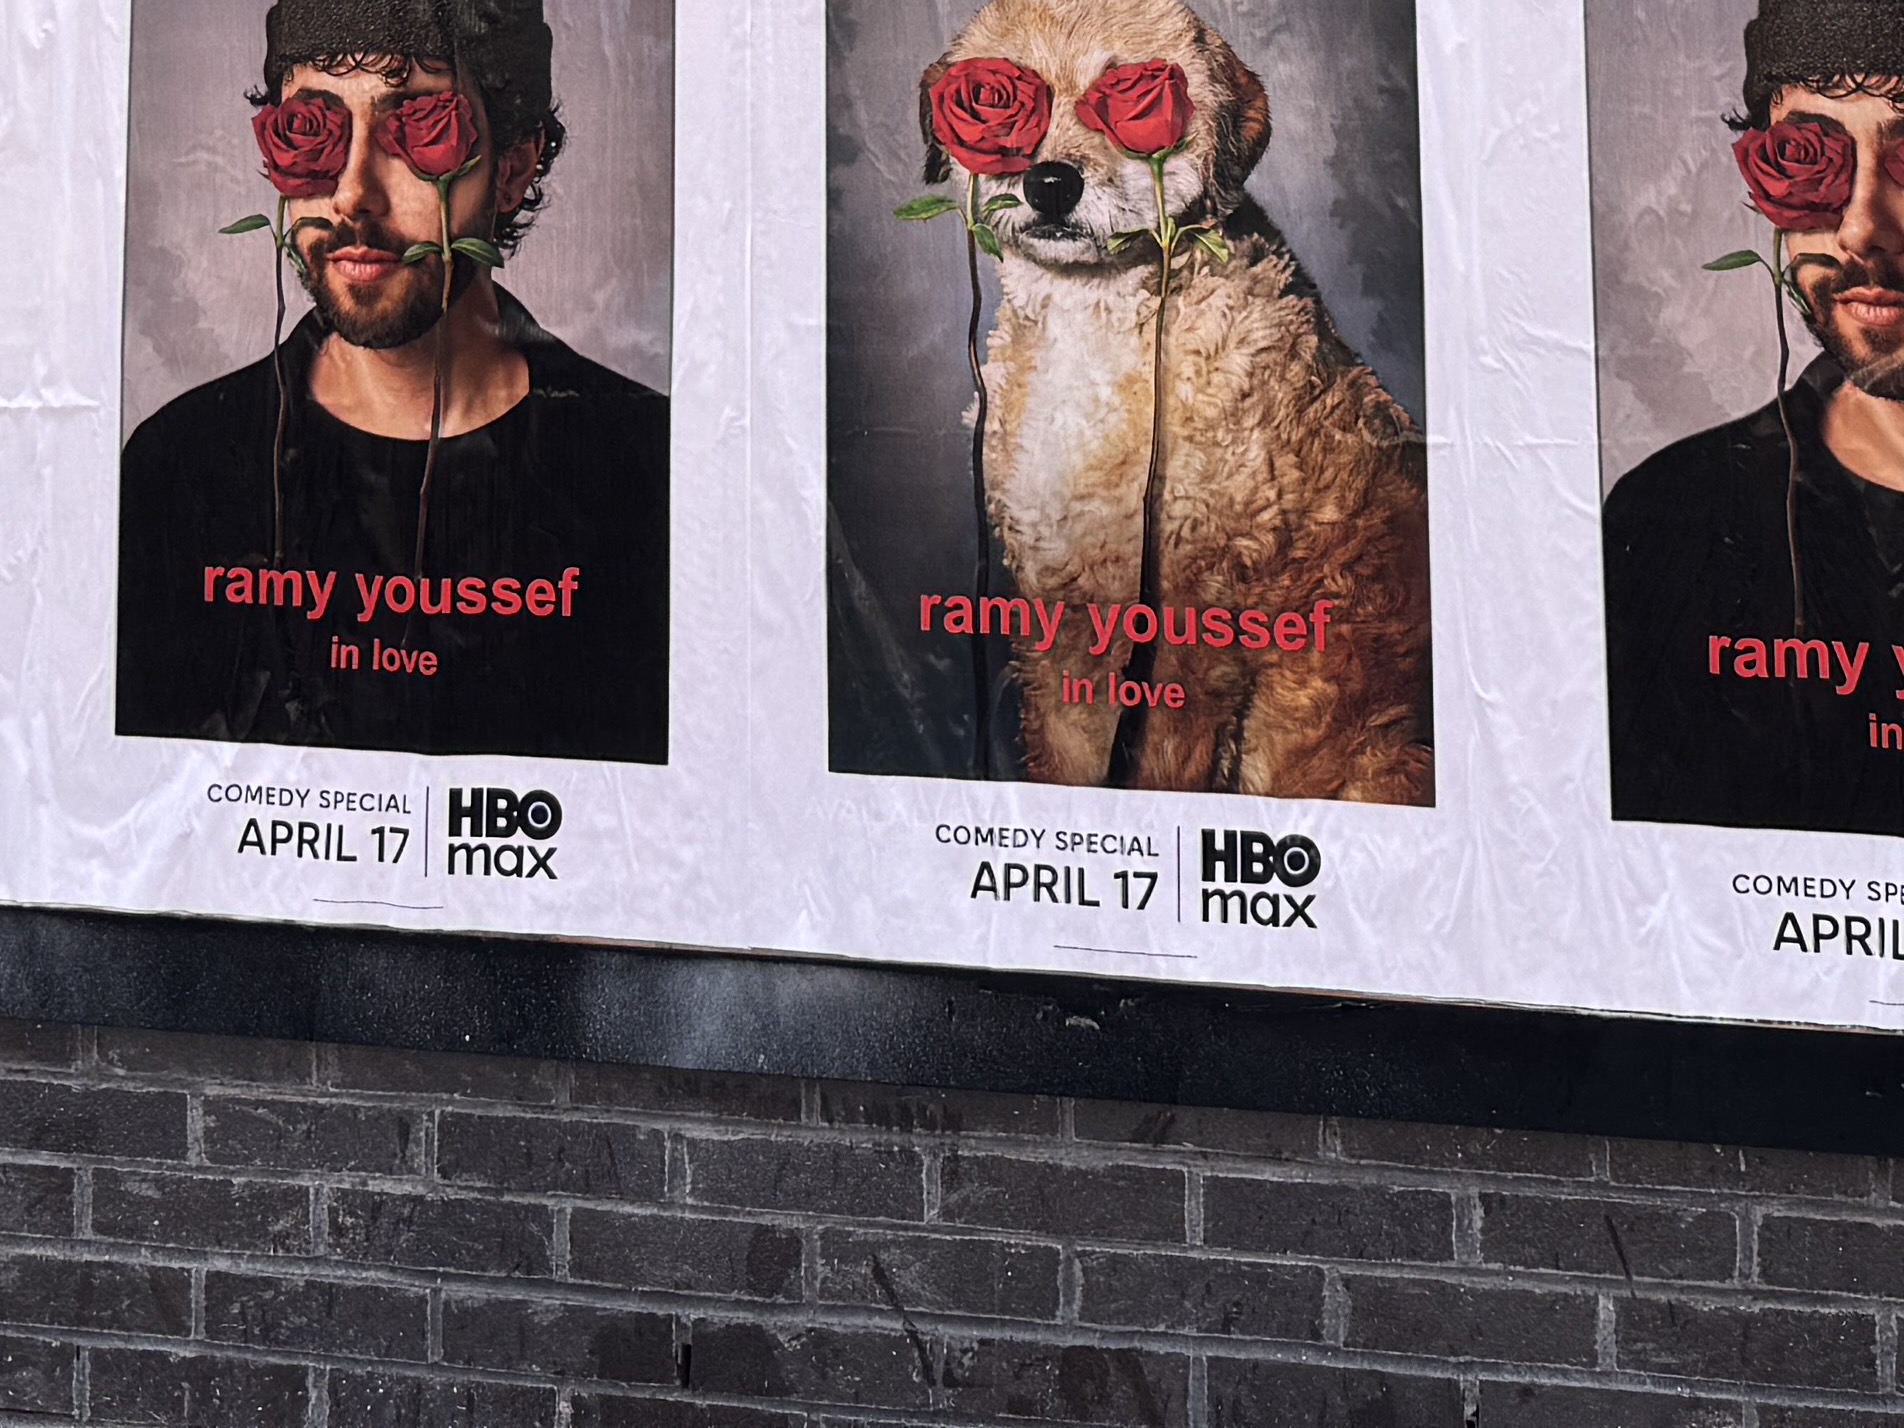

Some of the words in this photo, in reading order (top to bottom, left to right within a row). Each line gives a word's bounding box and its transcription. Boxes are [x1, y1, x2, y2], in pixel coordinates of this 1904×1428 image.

[204, 566, 336, 619] ramy
[355, 566, 579, 621] youssef
[920, 594, 1064, 652] ramy
[1087, 598, 1336, 655] youssef
[331, 636, 358, 669] in
[374, 641, 437, 675] love
[1708, 635, 1869, 695] ramy
[1062, 671, 1093, 704] in
[1109, 673, 1184, 708] love
[1869, 713, 1902, 749] in
[208, 784, 310, 808] COMEDY
[320, 790, 411, 814] SPECIAL
[449, 788, 562, 840] HBO
[238, 818, 357, 861] APRIL
[371, 826, 409, 863] 17
[936, 825, 1045, 848] COMEDY
[1056, 831, 1159, 856] SPECIAL
[1202, 829, 1321, 888] HBO
[448, 843, 557, 879] max
[971, 861, 1100, 907] APRIL
[1114, 871, 1158, 910] 17
[1733, 874, 1855, 899] COMEDY
[1202, 888, 1317, 928] max
